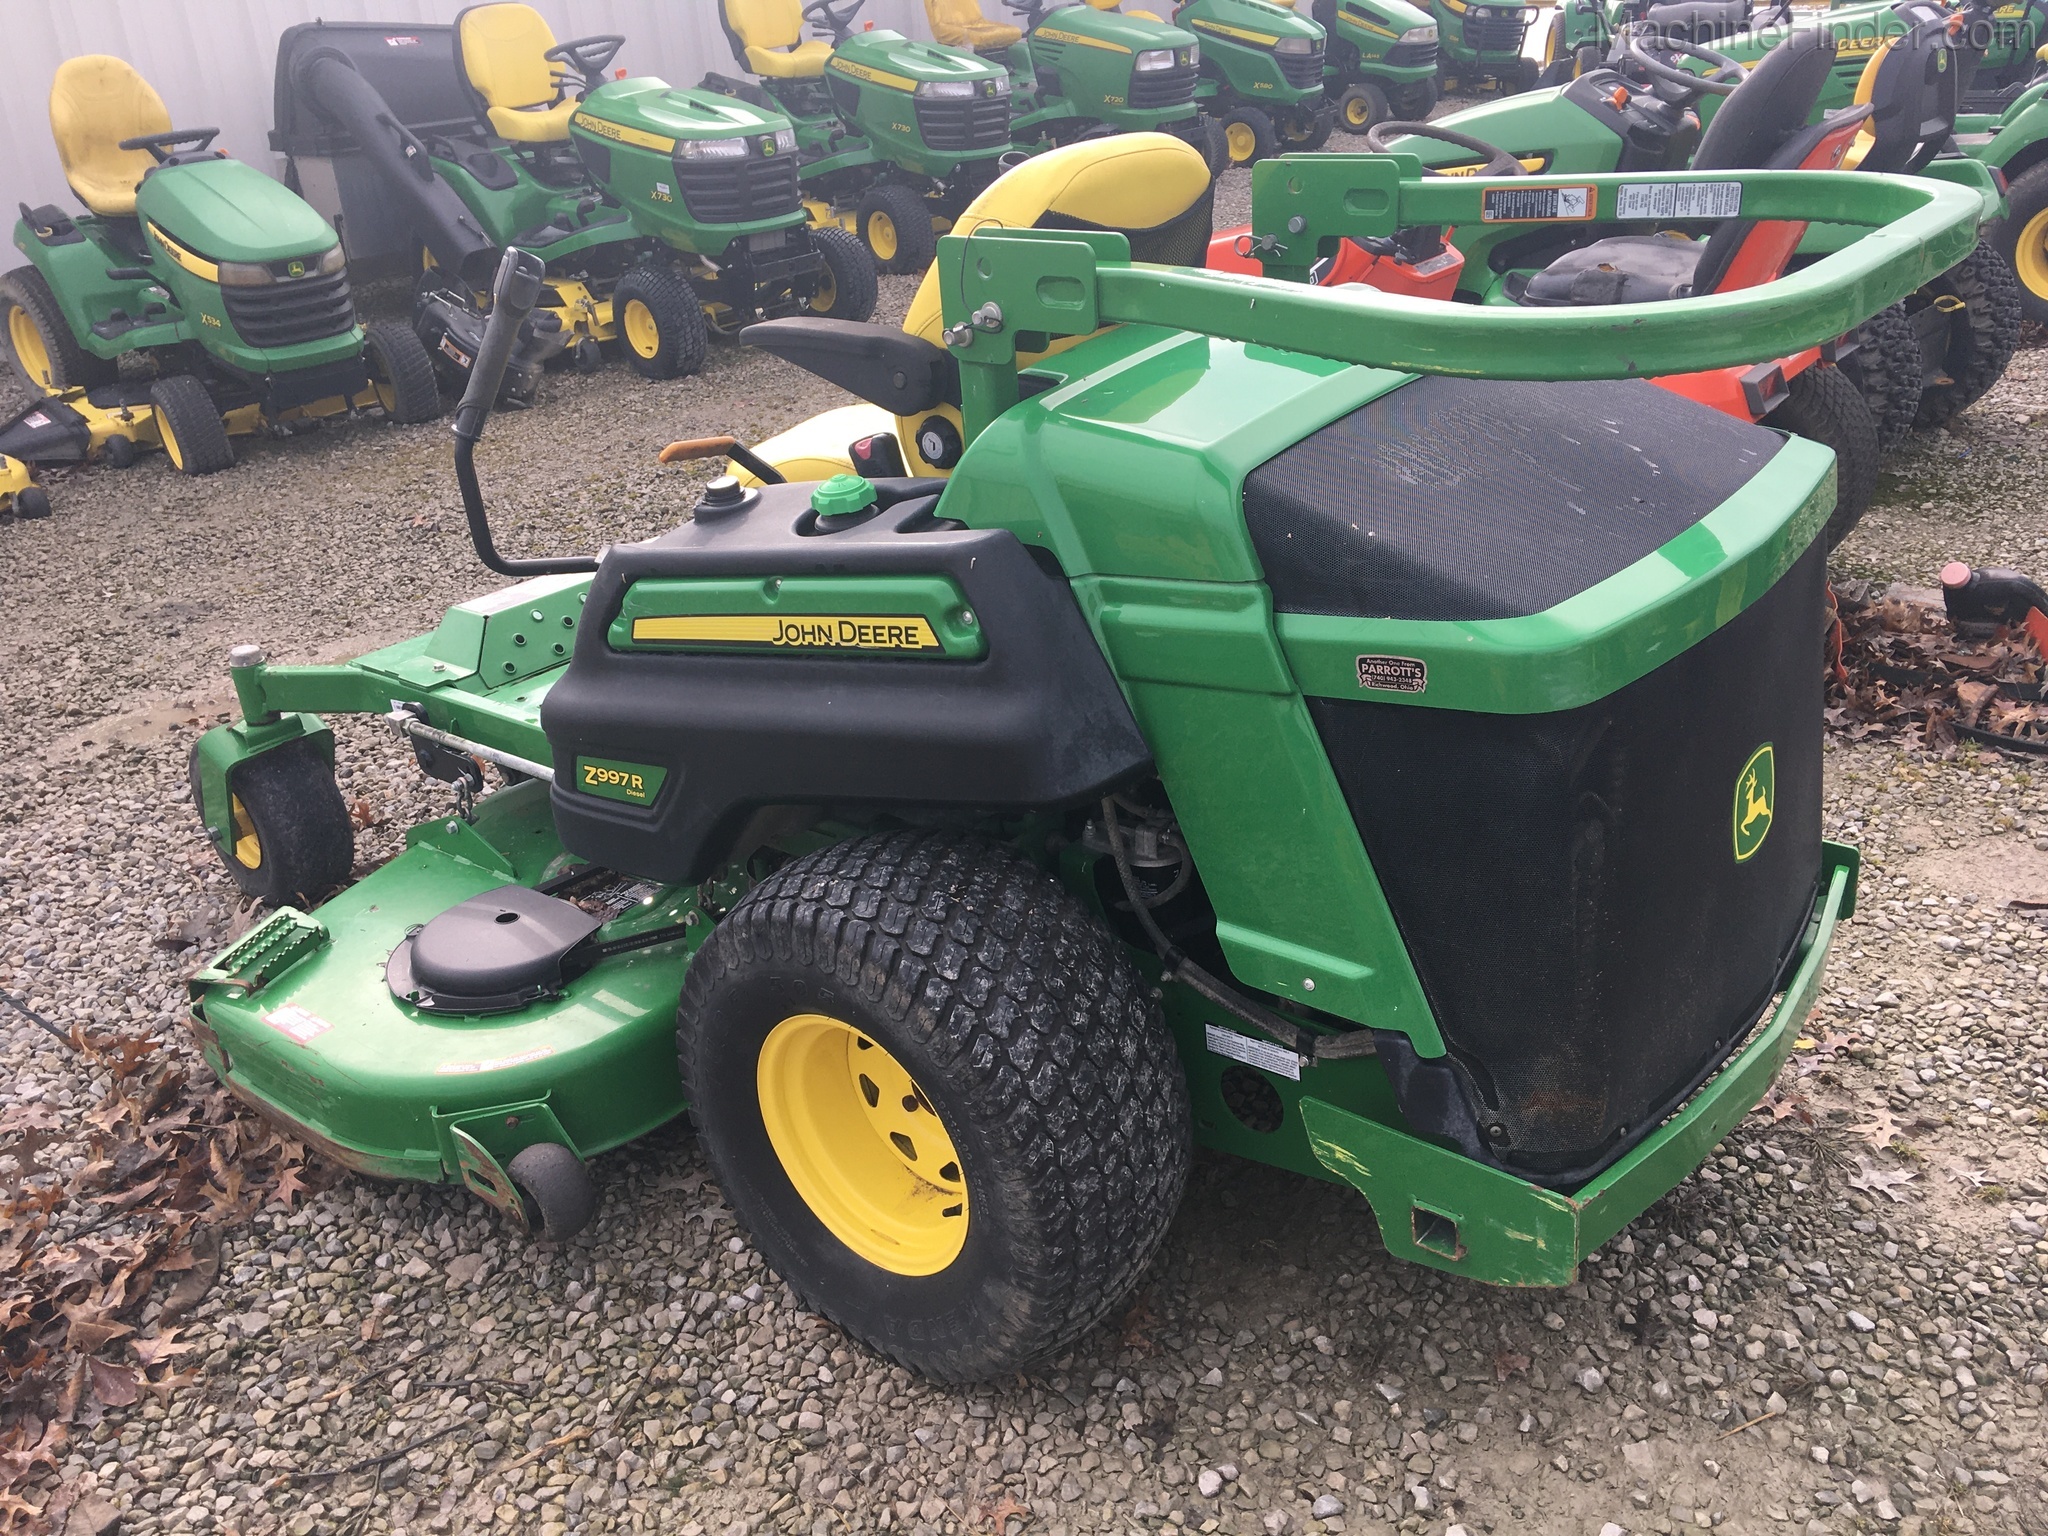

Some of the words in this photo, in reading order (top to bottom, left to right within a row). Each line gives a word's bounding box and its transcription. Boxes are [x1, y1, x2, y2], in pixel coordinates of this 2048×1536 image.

[1042, 29, 1059, 39] JOHN
[1059, 31, 1080, 43] DEERE
[835, 60, 851, 74] JOHN
[851, 64, 872, 80] DEERE
[1103, 94, 1124, 103] X720
[580, 115, 597, 132] JOHN
[597, 121, 622, 140] DEERE
[891, 122, 911, 133] X730
[650, 190, 673, 203] X730
[772, 619, 834, 644] JOHN
[837, 620, 921, 646] DEERE
[1366, 658, 1388, 666] Another
[1361, 663, 1422, 678] PARROTT'S
[626, 788, 646, 798] Diesel
